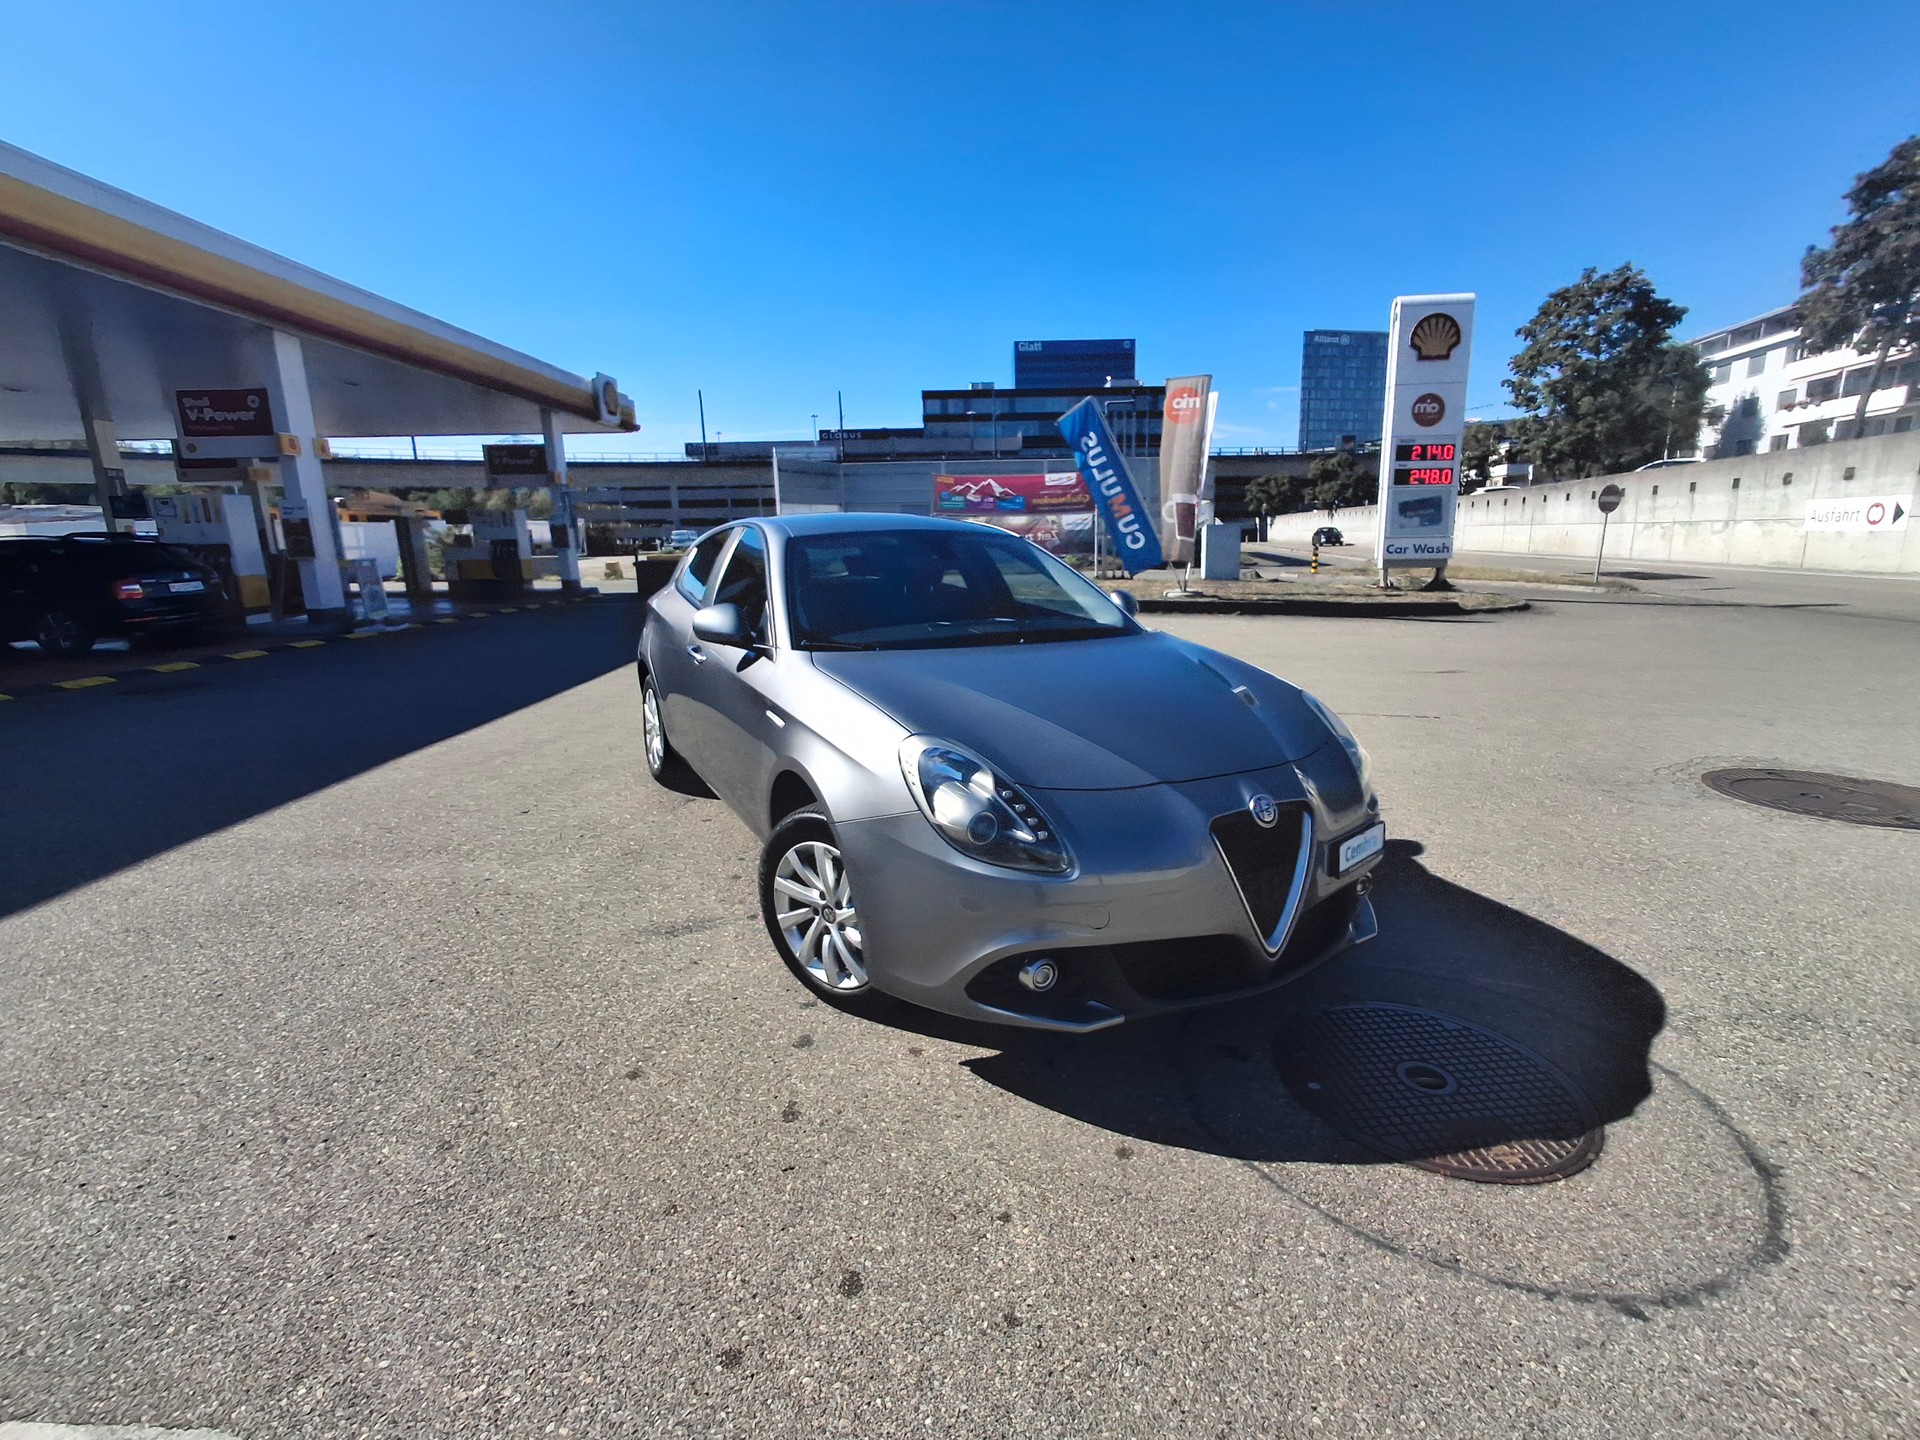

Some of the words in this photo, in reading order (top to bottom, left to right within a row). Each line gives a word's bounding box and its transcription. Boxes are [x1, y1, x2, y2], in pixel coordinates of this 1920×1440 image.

[1018, 341, 1042, 352] Glatt
[1414, 399, 1439, 414] mio
[185, 407, 256, 422] V-Power
[1409, 468, 1453, 485] 248.0
[1811, 508, 1860, 522] Ausfahrt
[1386, 544, 1409, 554] Car
[1413, 542, 1450, 554] Wash
